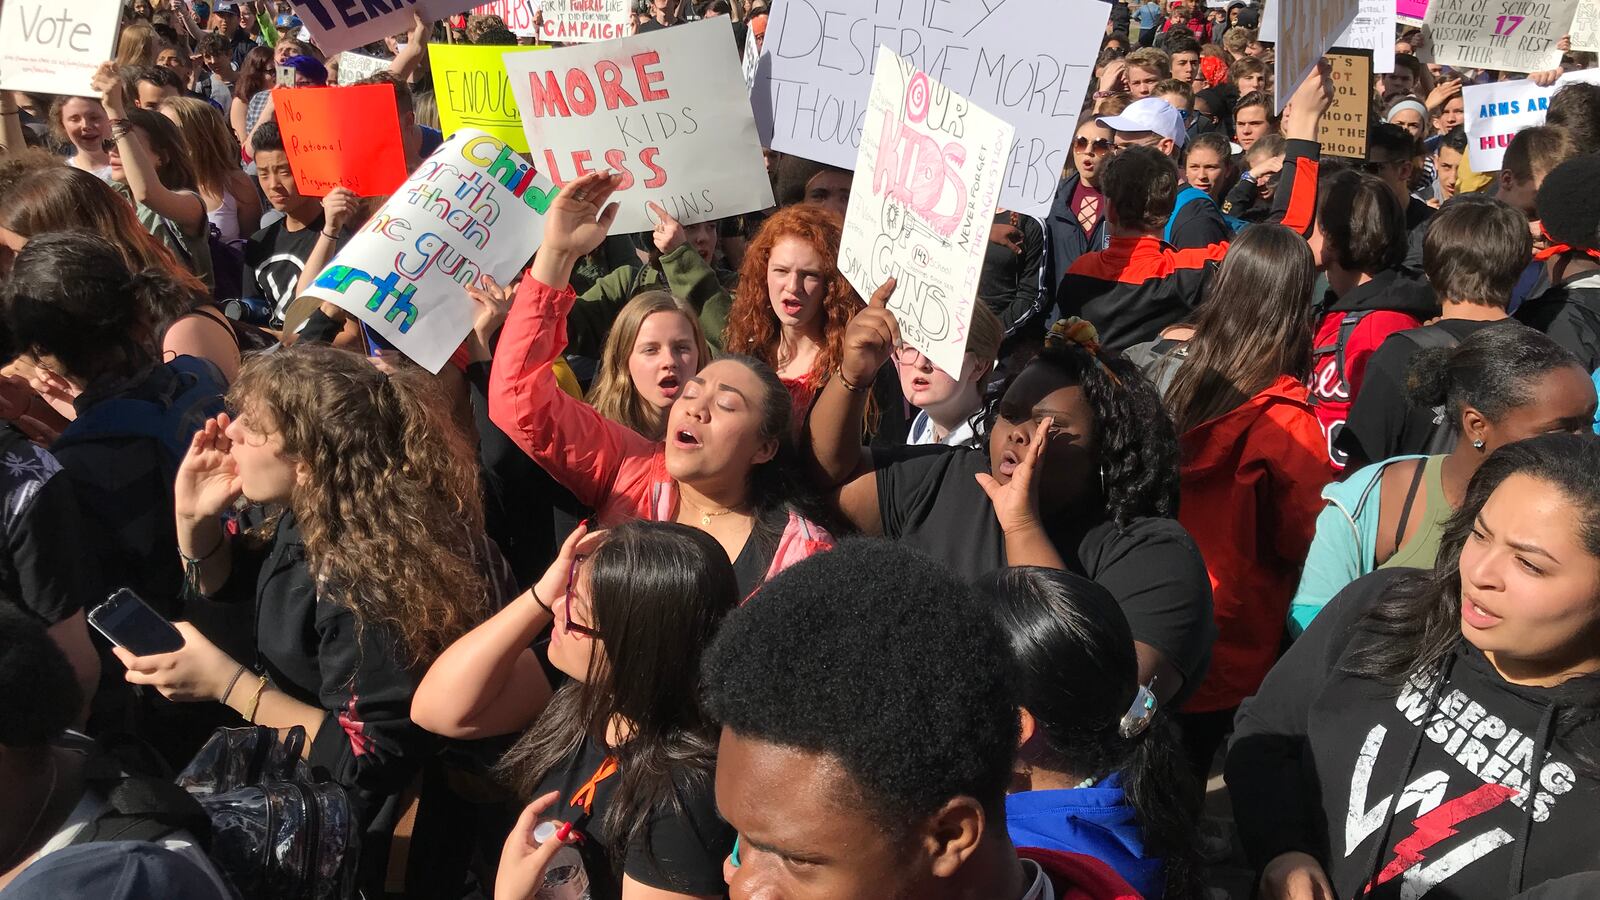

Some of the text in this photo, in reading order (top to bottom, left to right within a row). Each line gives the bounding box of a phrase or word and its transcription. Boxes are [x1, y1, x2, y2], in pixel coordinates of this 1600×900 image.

[567, 12, 581, 21] DID
[605, 0, 624, 13] LIKE
[1498, 0, 1552, 20] SCHOOL
[20, 4, 92, 53] Vote
[1433, 10, 1488, 29] BECAUSE
[1495, 15, 1526, 37] 17
[1527, 19, 1552, 37] ARE
[1456, 44, 1494, 64] THEIR
[1488, 33, 1512, 49] THE
[1517, 34, 1553, 53] REST
[1328, 55, 1353, 67] T'S
[528, 49, 670, 118] MORE
[968, 46, 1090, 118] MORE
[1332, 71, 1353, 82] OT
[445, 69, 521, 119] ENOUG
[1332, 98, 1340, 108] 2
[1333, 85, 1357, 96] OL
[282, 98, 303, 123] No
[766, 77, 868, 149] THOUG
[1321, 110, 1363, 122] HOOT
[1479, 96, 1551, 119] ARMS AR
[615, 105, 698, 147] KIDS
[1321, 126, 1366, 138] P THE
[290, 134, 343, 157] Rational
[1320, 141, 1366, 156] CHOOL
[300, 168, 360, 191] Arguments!
[460, 135, 560, 216] Child
[543, 146, 668, 192] LESS
[873, 108, 968, 238] KIDS
[406, 158, 501, 250] orth than
[957, 144, 988, 253] NEVER FORGET
[315, 264, 419, 335] arth
[871, 232, 950, 342] GUNS
[951, 298, 971, 345] WHY
